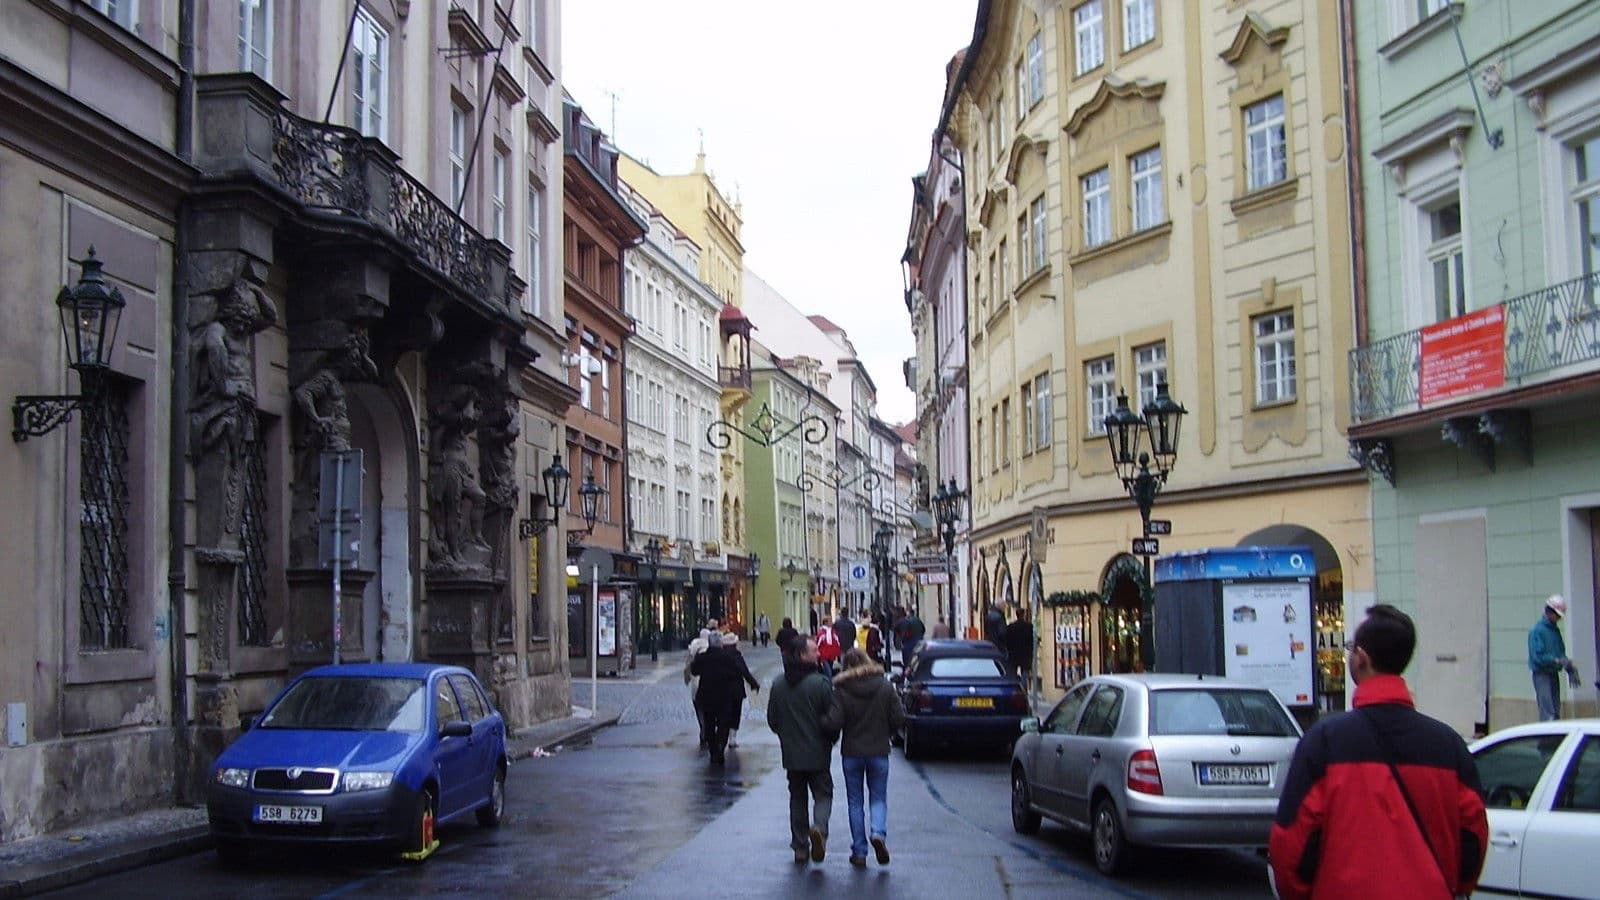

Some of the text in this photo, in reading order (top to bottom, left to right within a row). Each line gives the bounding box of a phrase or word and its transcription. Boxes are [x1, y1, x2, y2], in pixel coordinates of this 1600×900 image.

[1144, 540, 1157, 553] WC
[1057, 626, 1080, 641] SALE
[289, 808, 318, 820] 6279
